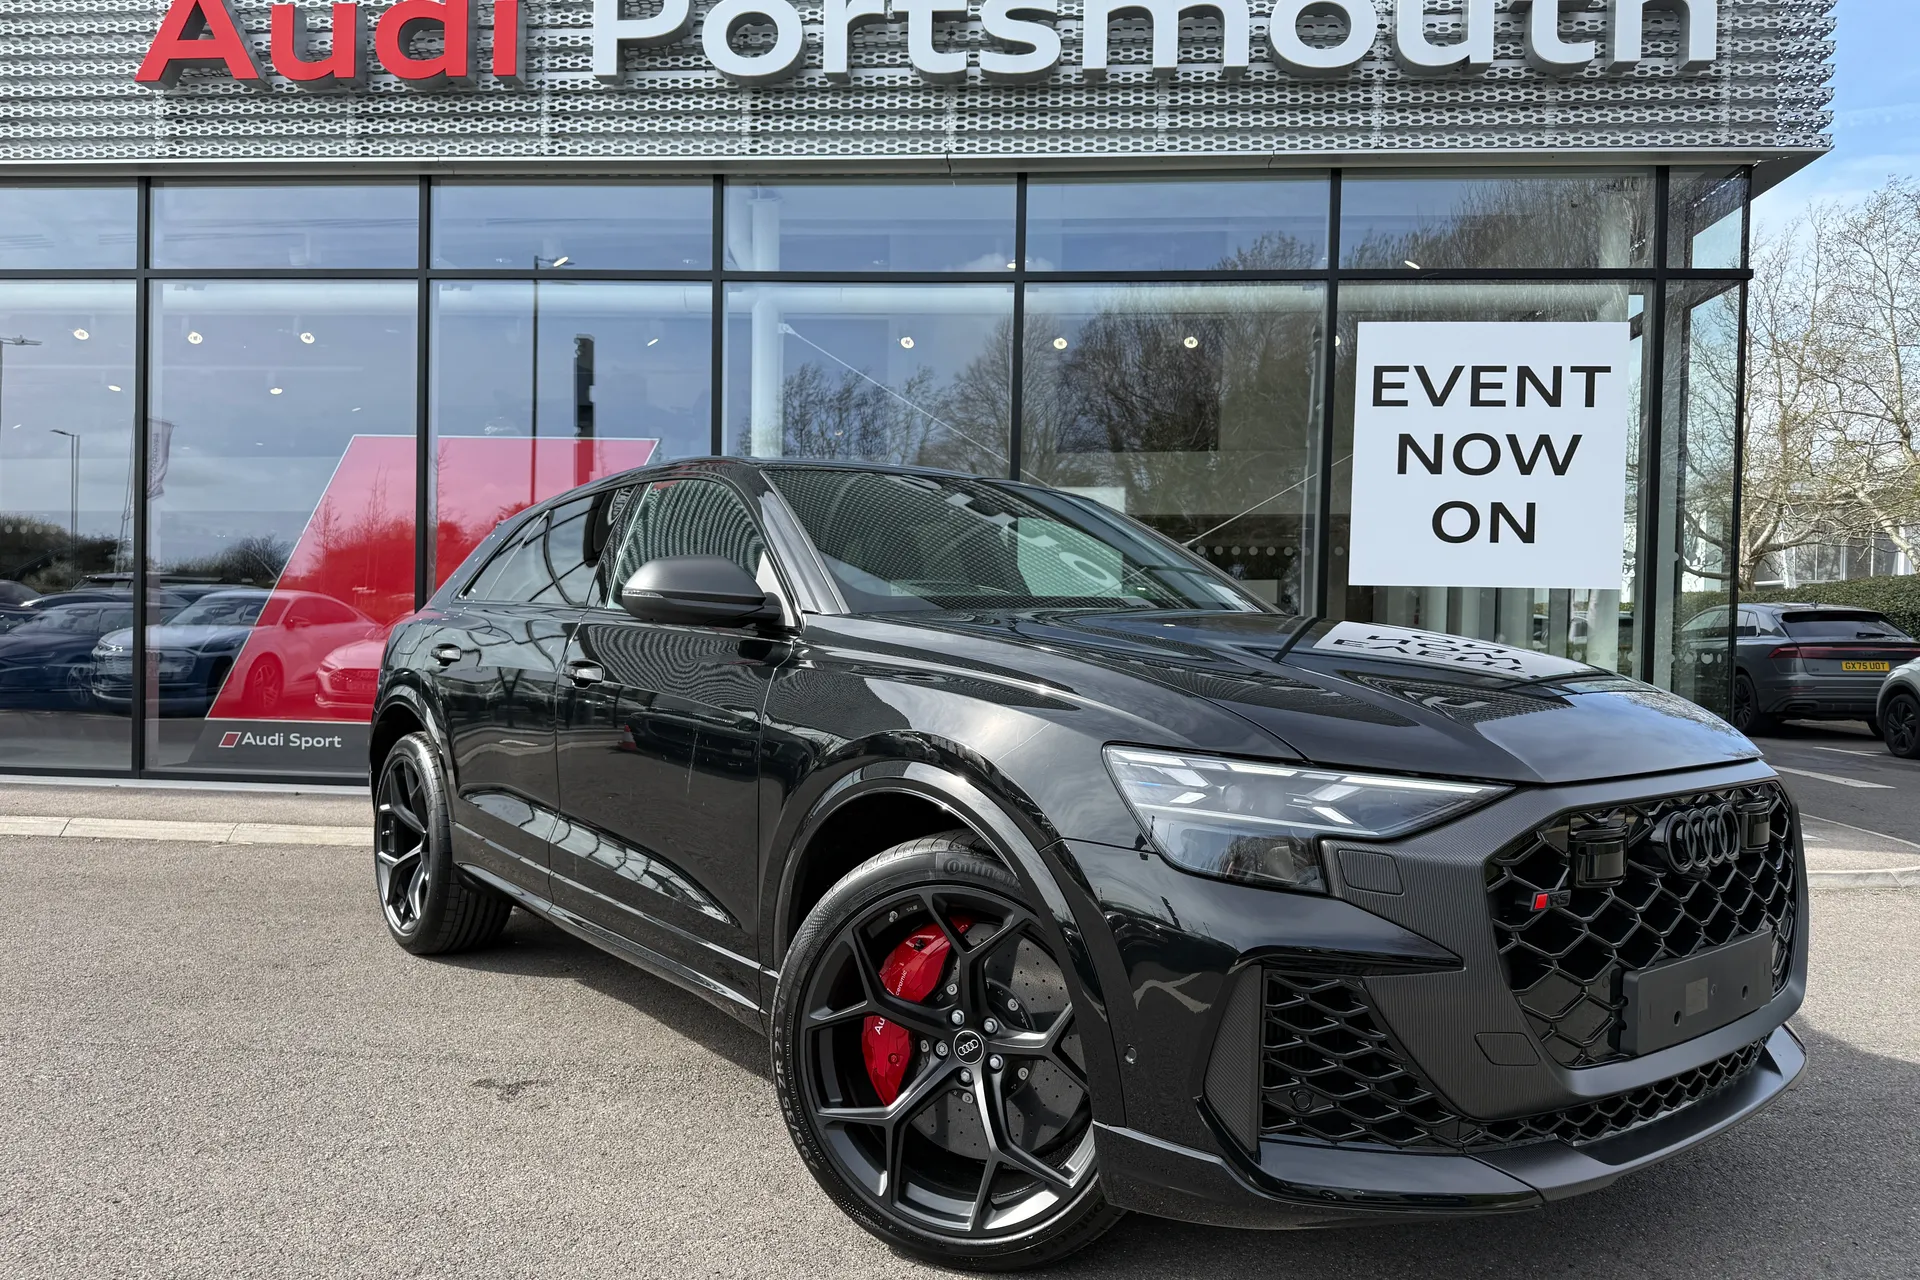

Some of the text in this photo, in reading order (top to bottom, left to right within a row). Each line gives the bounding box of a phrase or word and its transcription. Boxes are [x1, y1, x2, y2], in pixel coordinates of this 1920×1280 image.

[135, 0, 1717, 84] Audi Portsmouth
[1372, 365, 1612, 408] EVENT
[1397, 432, 1583, 476] NOW
[1432, 500, 1537, 544] ON
[1845, 661, 1868, 670] GX75
[241, 731, 342, 750] Audi Sport
[896, 969, 908, 996] ceramic
[774, 1026, 783, 1054] 23
[874, 1017, 886, 1035] Au
[775, 1061, 787, 1090] ZR
